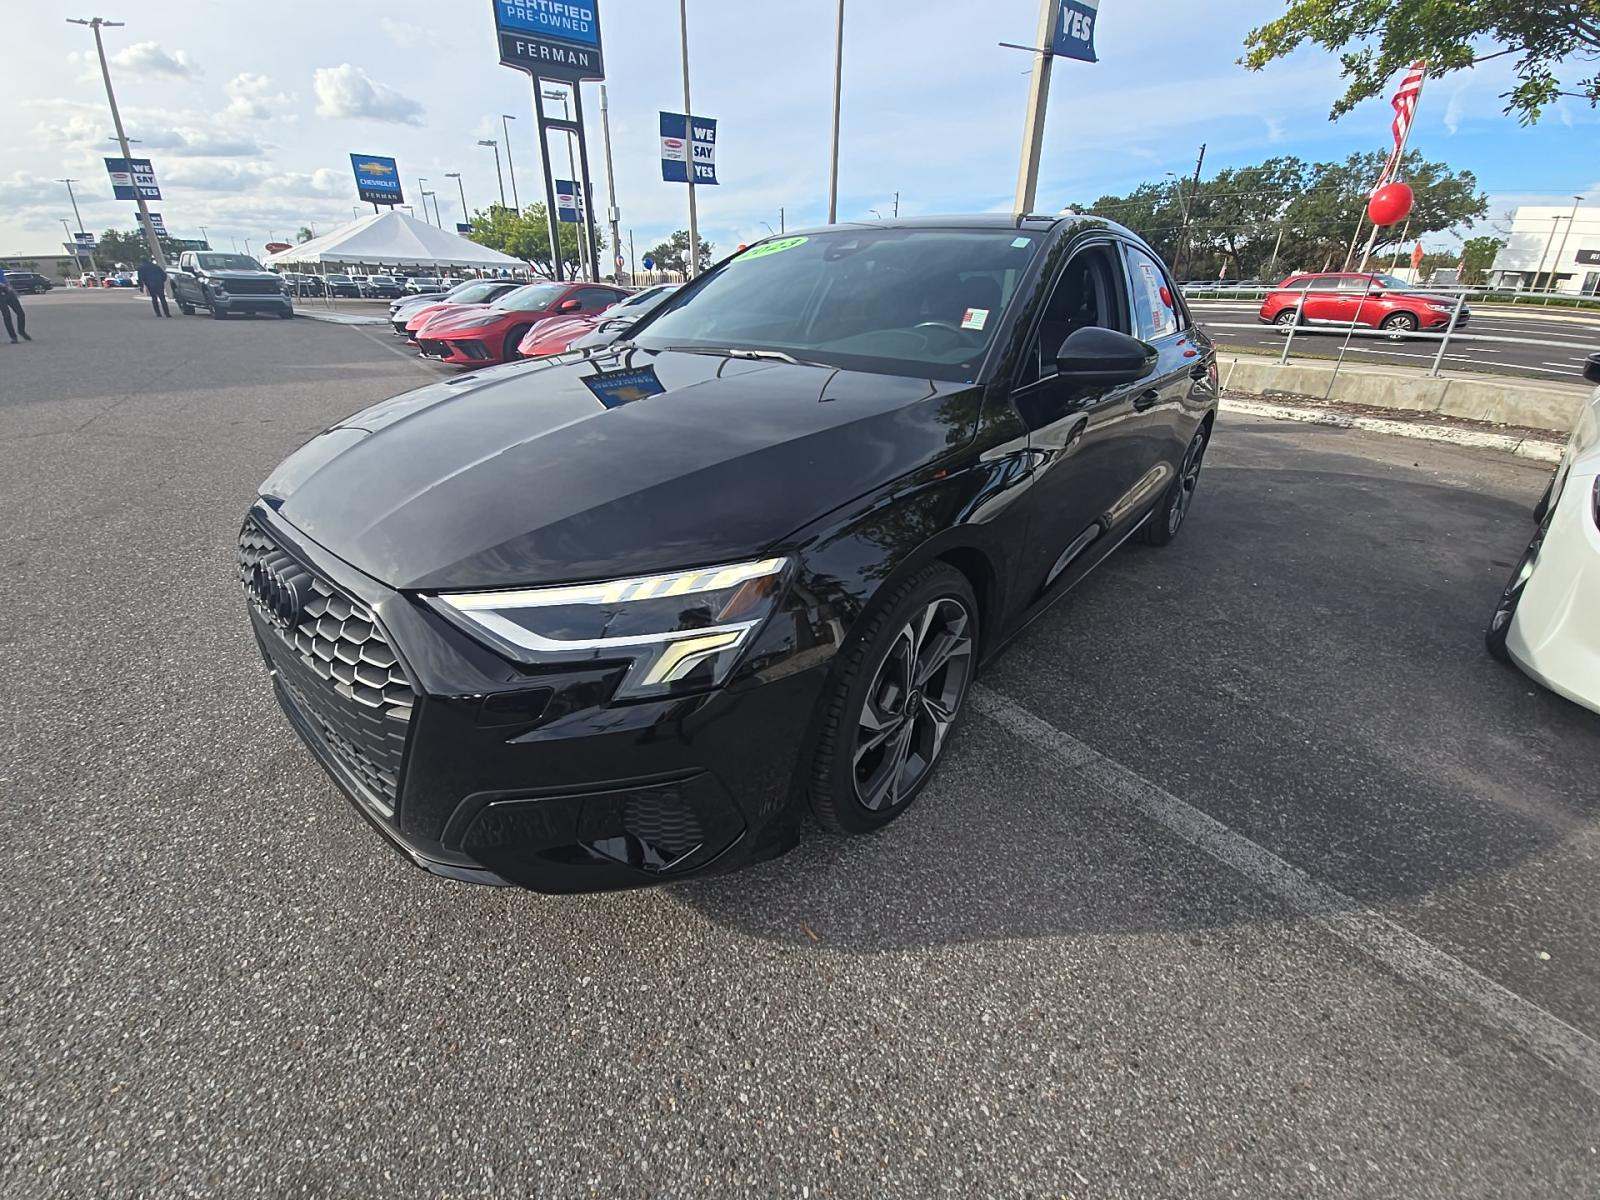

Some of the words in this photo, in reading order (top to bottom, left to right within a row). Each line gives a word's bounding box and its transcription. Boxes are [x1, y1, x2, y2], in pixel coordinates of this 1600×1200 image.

[507, 6, 589, 32] PRE-OWNED
[1063, 6, 1092, 41] YES
[516, 41, 589, 66] FERMAN
[694, 127, 714, 141] WE
[694, 146, 712, 159] SAY
[695, 165, 714, 179] YES
